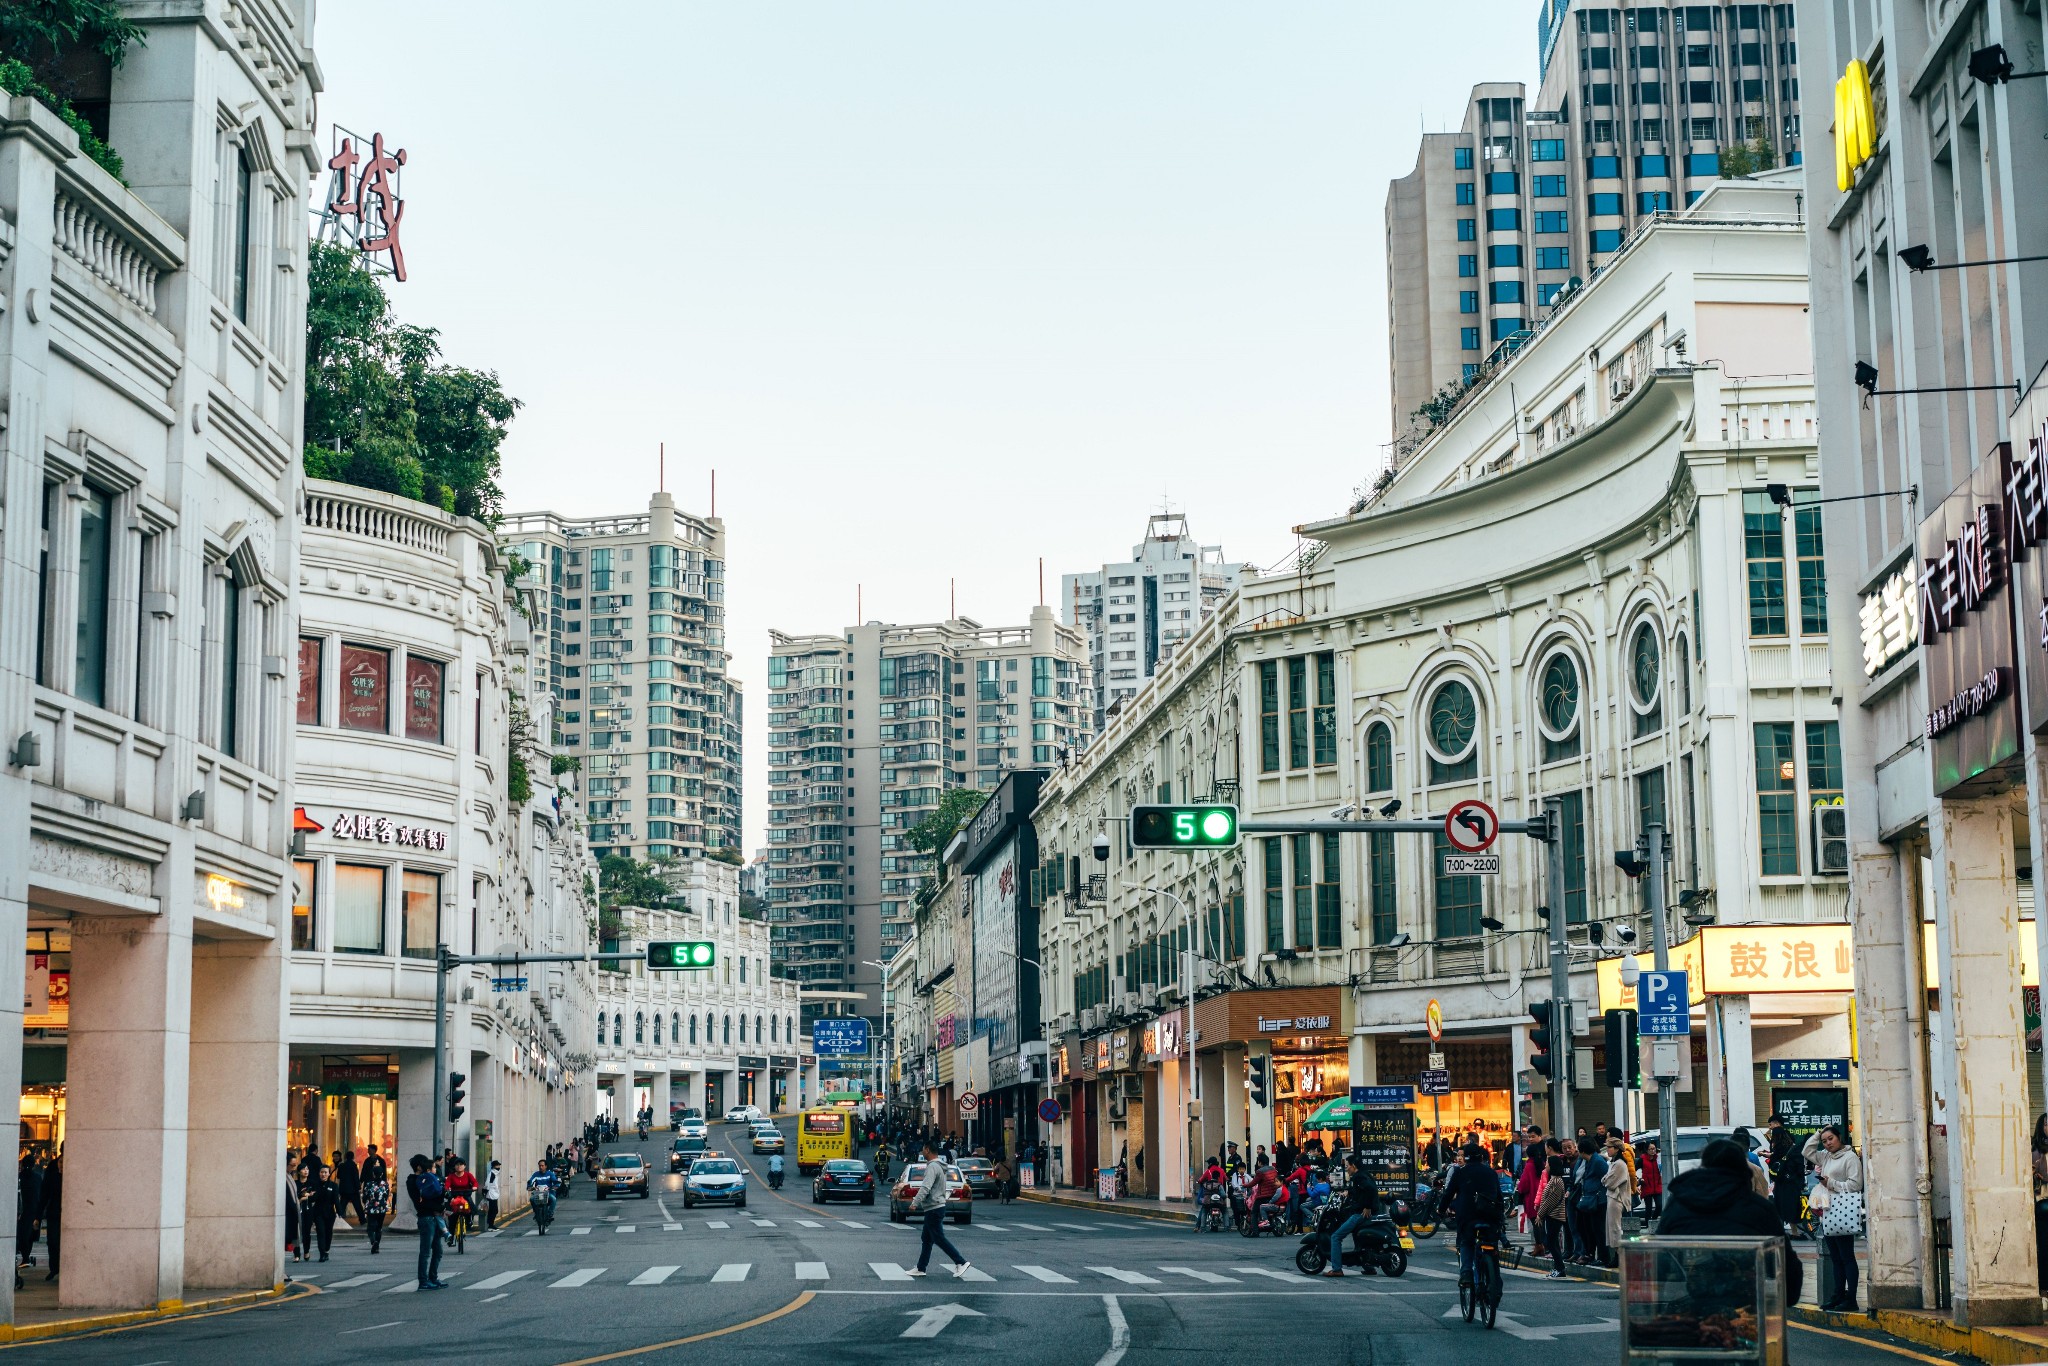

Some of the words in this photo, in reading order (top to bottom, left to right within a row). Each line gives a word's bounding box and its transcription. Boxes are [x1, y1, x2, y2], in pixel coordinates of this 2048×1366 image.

[1918, 521, 1980, 645] 大丰收
[351, 676, 375, 688] 必胜客
[413, 688, 432, 699] 必胜客
[334, 814, 396, 843] 必胜客
[398, 826, 449, 850] 欢乐餐厅
[1176, 814, 1194, 839] 5
[675, 946, 688, 964] 5
[1647, 973, 1669, 1003] P
[1295, 1016, 1330, 1029] 爱依服
[1651, 1016, 1677, 1024] 老虎城
[1651, 1024, 1678, 1032] 停车场
[1791, 1062, 1828, 1071] 养元宫巷
[1779, 1099, 1809, 1114] 瓜子
[1781, 1115, 1842, 1126] 二手车直卖网
